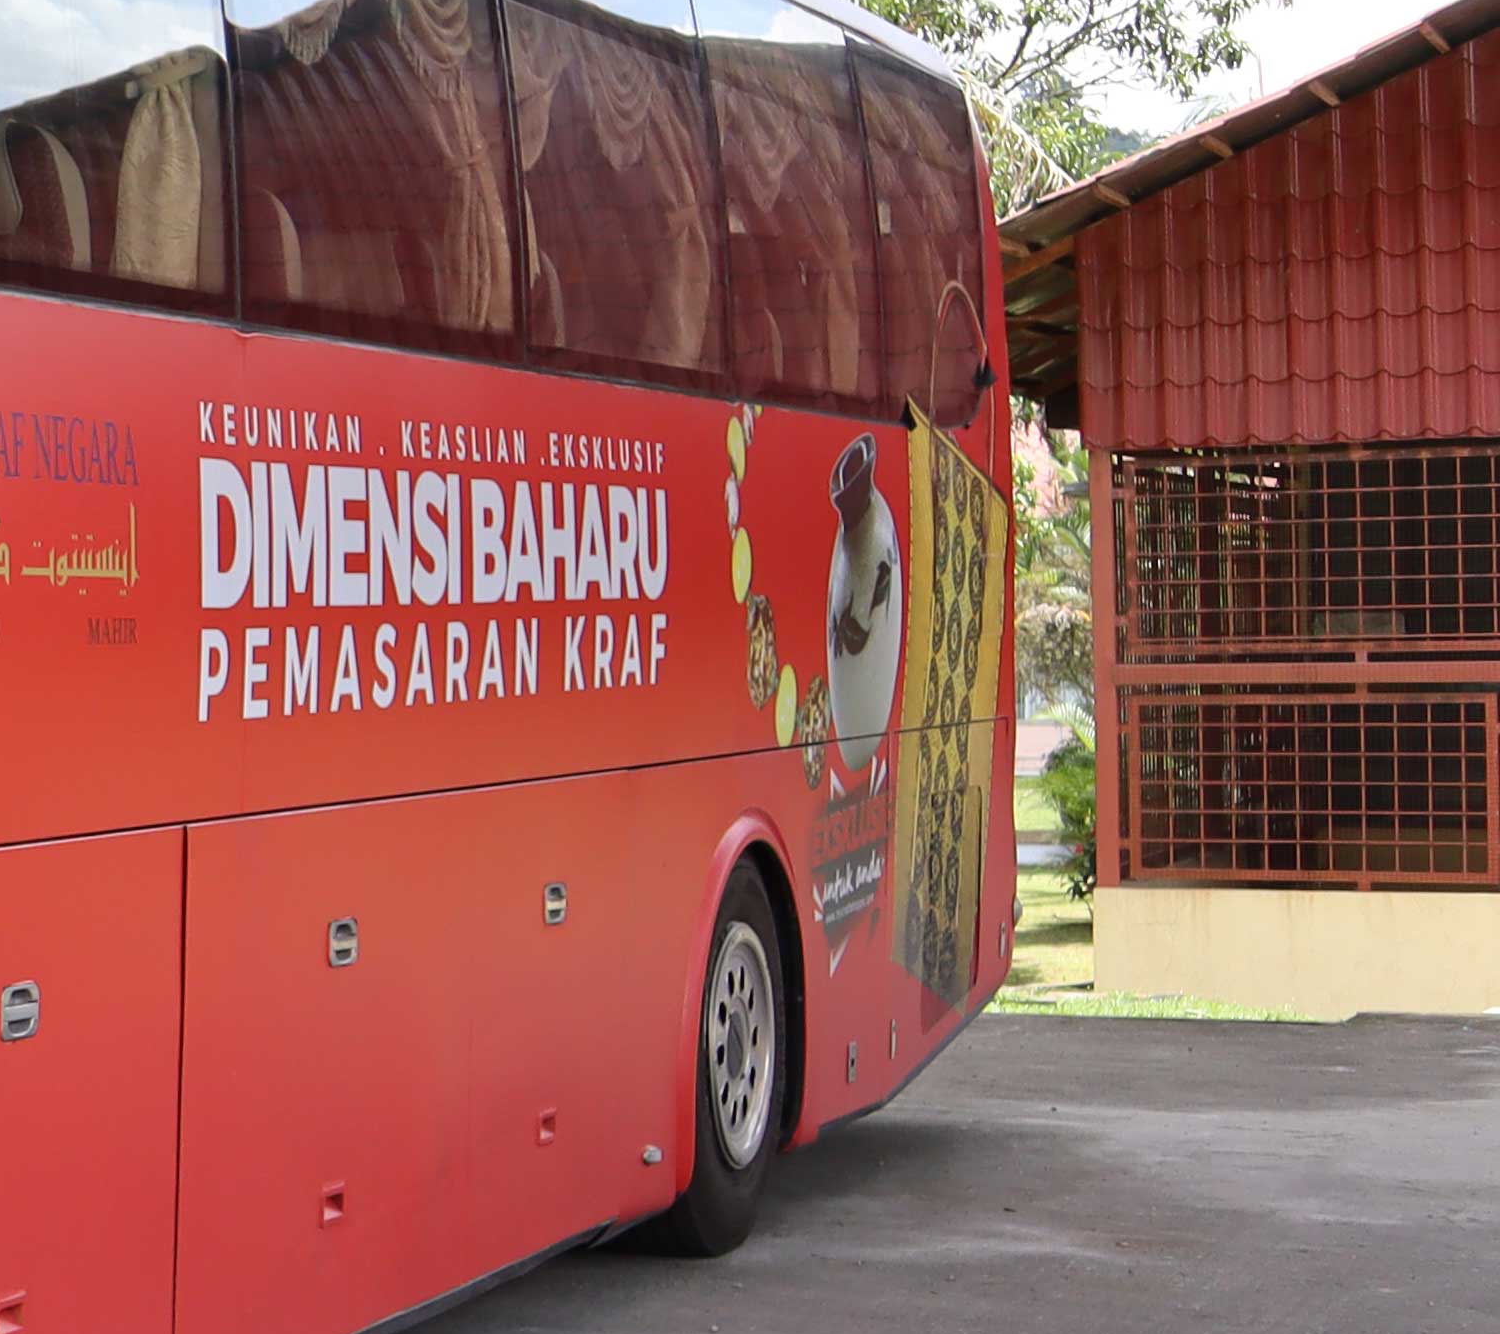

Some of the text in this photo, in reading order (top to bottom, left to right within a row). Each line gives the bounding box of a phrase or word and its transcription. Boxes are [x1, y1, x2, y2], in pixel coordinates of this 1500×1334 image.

[31, 413, 139, 486] NEGARA
[199, 401, 361, 454] KEUNIKAN
[401, 420, 525, 465] KEASLIAN
[199, 456, 668, 609] DIMENSI BAHARU
[88, 617, 138, 645] MAHIR
[198, 613, 667, 722] PEMASARAN KRAF
